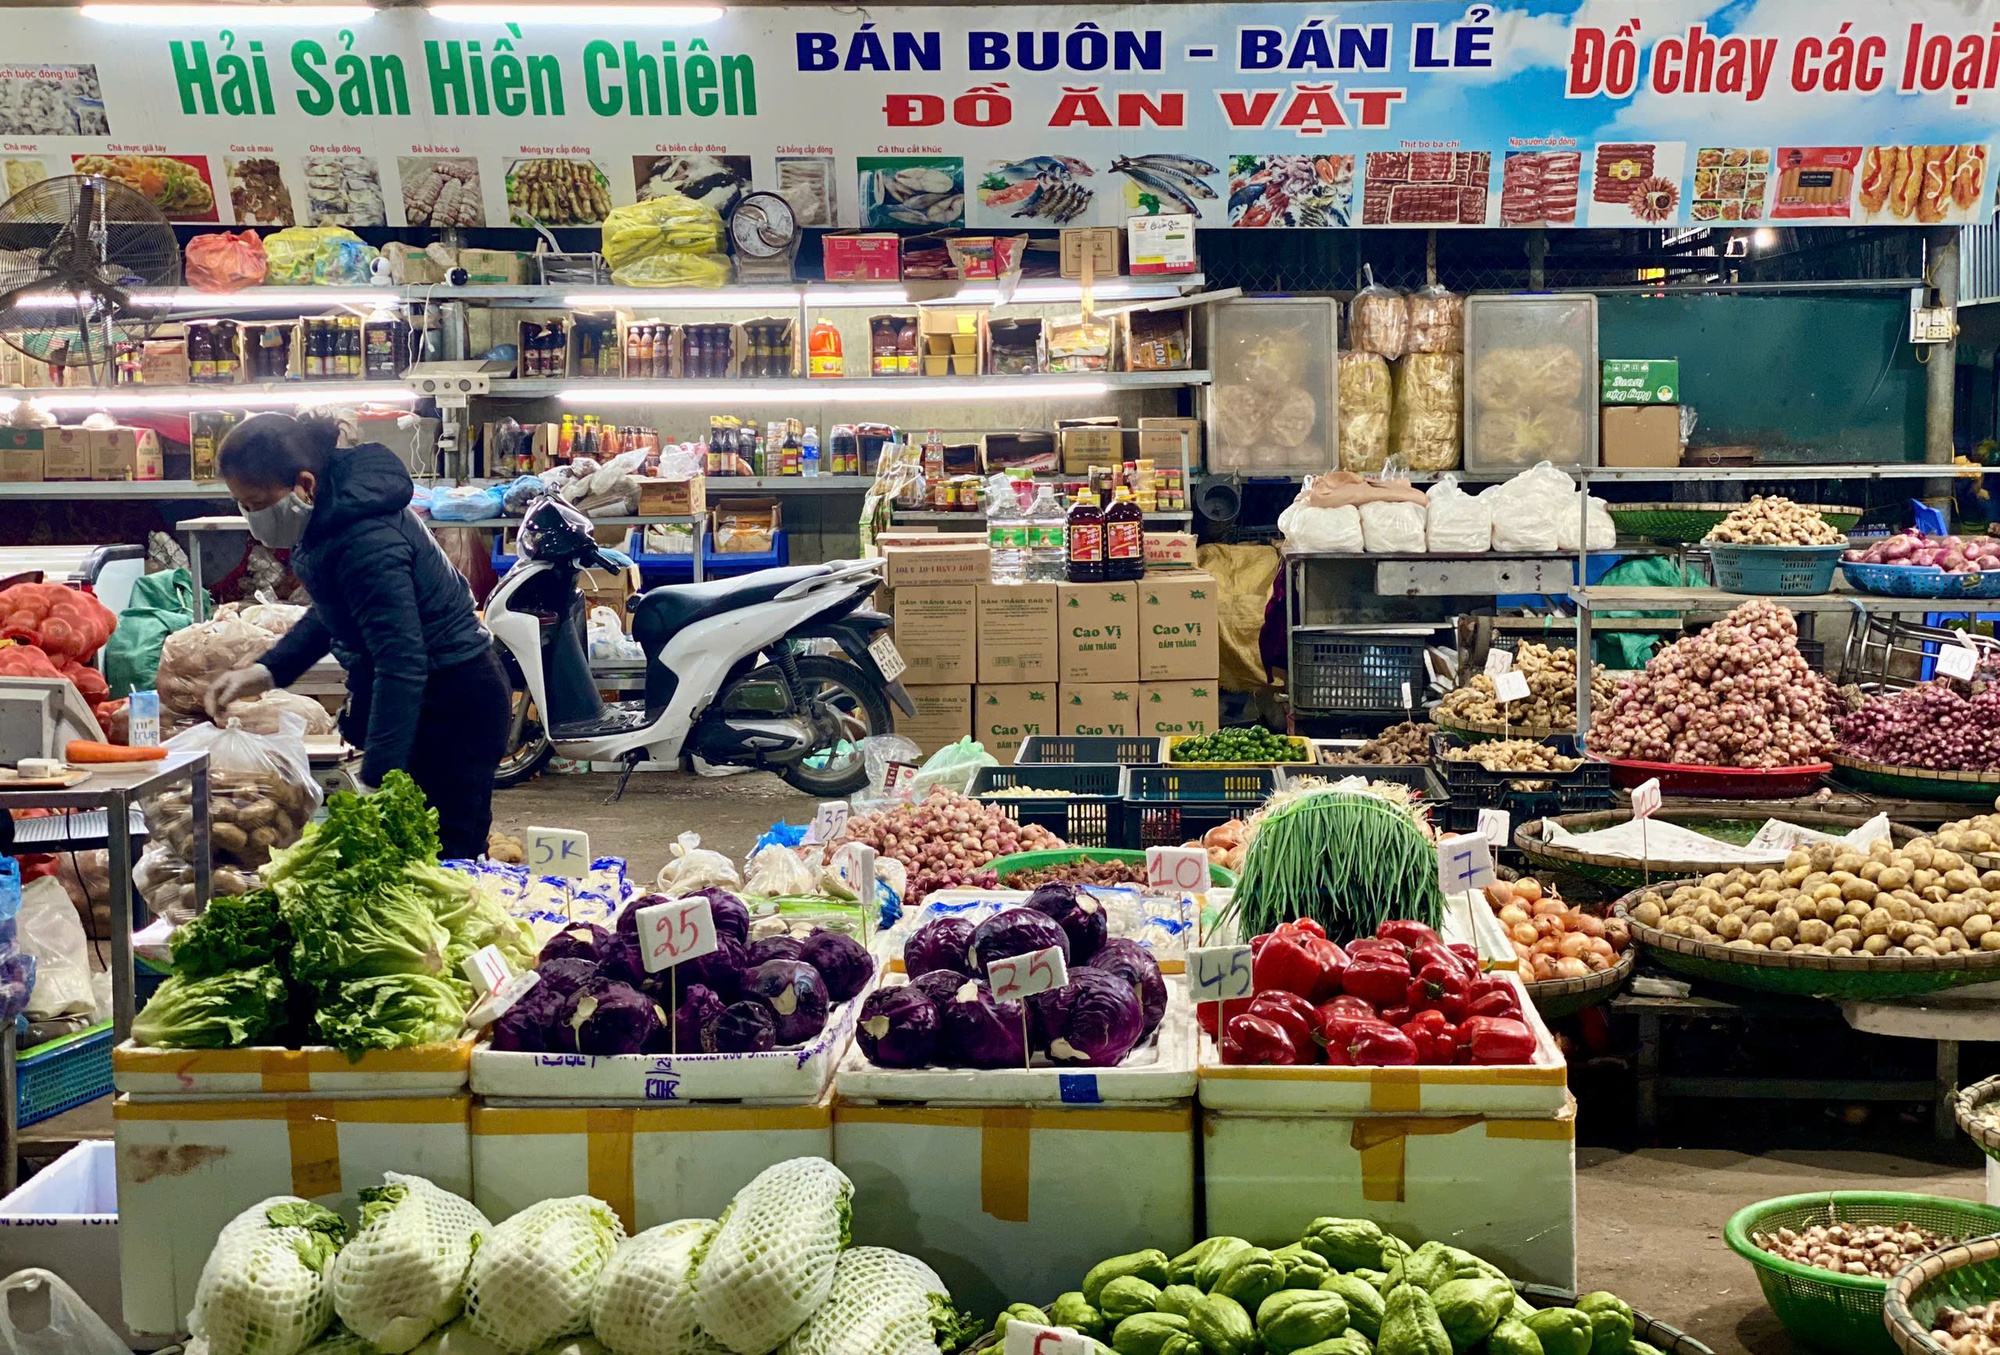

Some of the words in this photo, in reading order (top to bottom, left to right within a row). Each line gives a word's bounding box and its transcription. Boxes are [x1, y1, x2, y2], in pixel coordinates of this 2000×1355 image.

[796, 23, 942, 72] BÁN
[967, 22, 1163, 71] BUÔN
[1239, 21, 1387, 69] BÁN
[1414, 6, 1493, 68] LẺ
[170, 29, 276, 117] Hải
[291, 29, 412, 117] Sản
[425, 23, 567, 117] Hiền
[583, 37, 758, 117] Chiên
[1570, 18, 1641, 94] Đồ
[1651, 24, 1778, 101] chay
[1800, 22, 1884, 91] các
[1901, 21, 2000, 106] loại
[882, 82, 1013, 127] ĐỒ
[1047, 86, 1184, 127] ĂN
[1221, 85, 1405, 134] VẶT
[1072, 627, 1100, 638] Cao
[1104, 625, 1122, 639] Vị
[1152, 624, 1180, 635] Cao
[1184, 622, 1202, 636] Vị
[134, 730, 158, 740] true
[991, 724, 1018, 735] Cao
[1075, 724, 1103, 736] Cao
[1155, 721, 1183, 732] Cao
[1641, 785, 1660, 817] 10
[823, 808, 849, 840] 35
[1149, 852, 1202, 889] 10
[1453, 850, 1491, 887] 7
[653, 904, 701, 958] 25
[990, 951, 1054, 997] 25
[1199, 948, 1251, 998] 45
